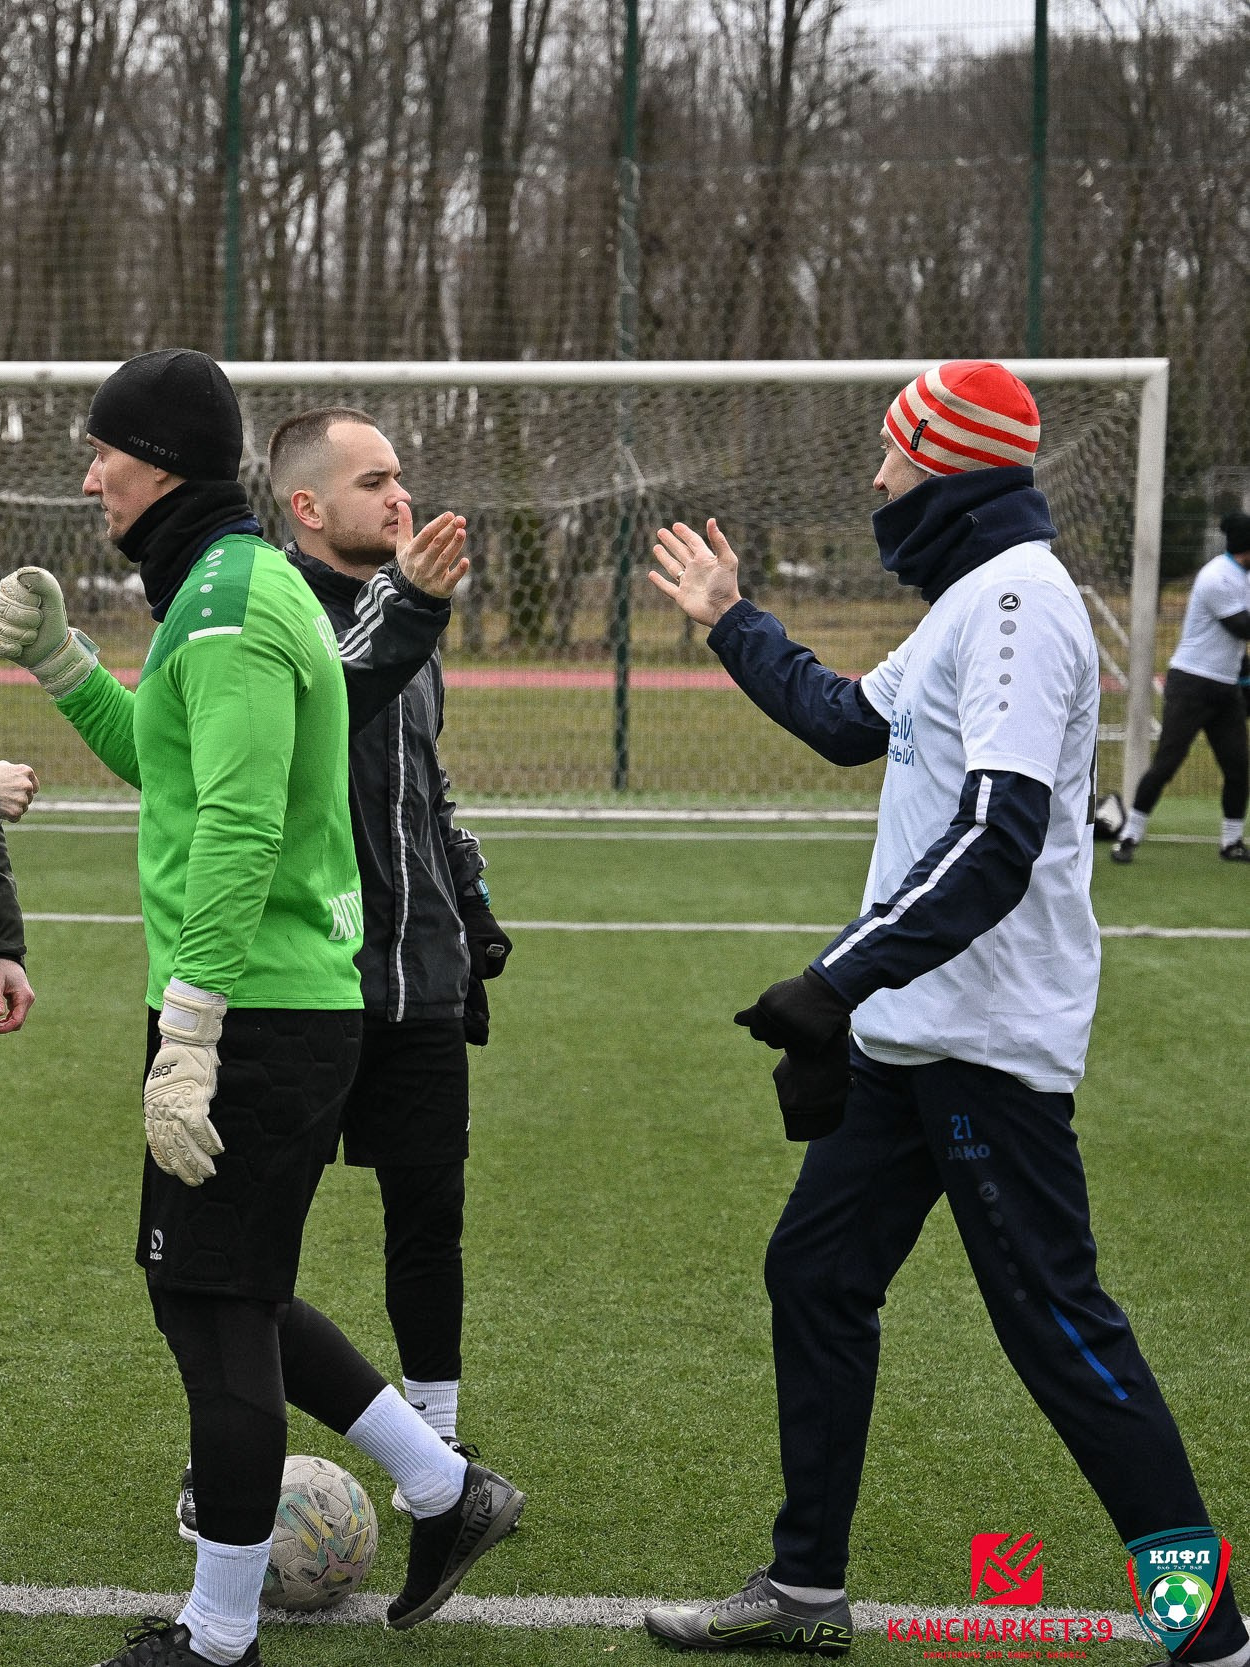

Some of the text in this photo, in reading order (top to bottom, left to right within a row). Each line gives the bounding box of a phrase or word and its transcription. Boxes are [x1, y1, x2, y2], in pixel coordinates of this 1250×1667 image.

[128, 435, 180, 461] JUST DO IT
[951, 1114, 972, 1139] 21
[947, 1143, 990, 1160] JAKO
[477, 1487, 492, 1510] NIKE
